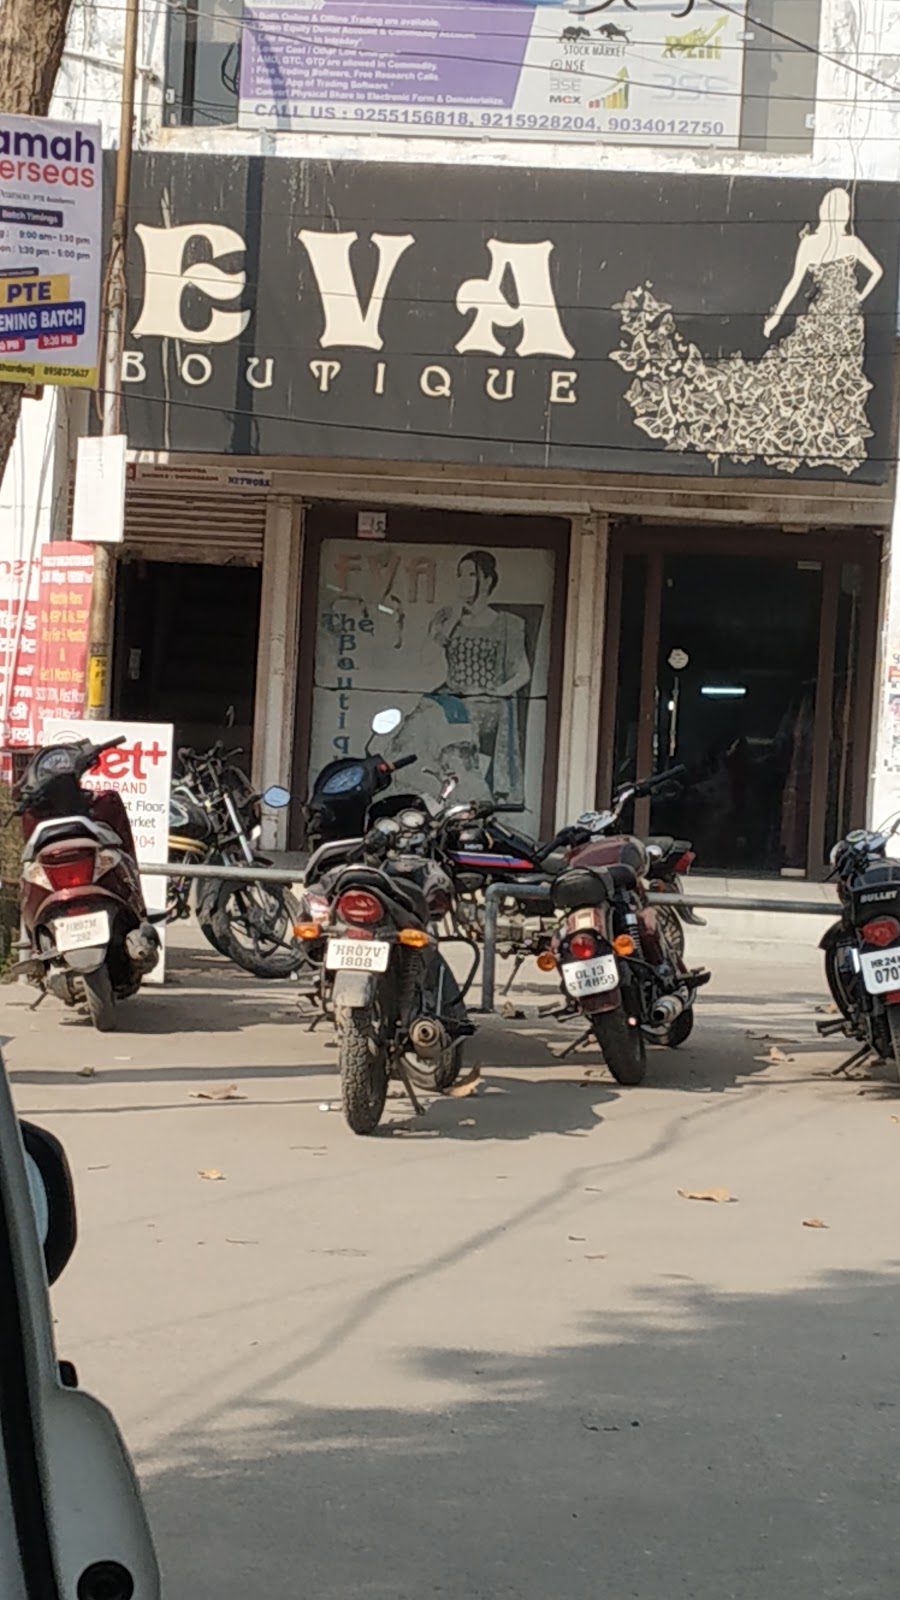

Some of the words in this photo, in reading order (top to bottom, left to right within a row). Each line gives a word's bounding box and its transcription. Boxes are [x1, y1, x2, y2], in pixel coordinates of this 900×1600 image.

[350, 15, 383, 27] Trading
[283, 24, 311, 34] Equity
[563, 44, 590, 56] STOCK
[592, 46, 627, 57] MARKET
[565, 60, 586, 71] NSE
[279, 67, 310, 77] Trading
[353, 69, 373, 78] Free
[374, 70, 416, 80] Research
[316, 79, 349, 90] Trading
[328, 90, 355, 99] Share
[411, 94, 435, 102] Form
[550, 95, 582, 104] MCX
[255, 103, 300, 118] CALL
[310, 105, 336, 119] US
[608, 117, 724, 136] 9034012750
[76, 237, 91, 245] pm
[36, 248, 50, 257] pm
[77, 252, 91, 260] pm
[7, 281, 52, 303] PTE
[131, 223, 576, 359] EVA
[41, 308, 82, 328] BATCH
[61, 335, 73, 344] PM
[121, 351, 577, 403] BOUTIQUE
[322, 612, 375, 636] The
[332, 634, 359, 759] Boutiq
[137, 801, 165, 814] Floor,
[860, 891, 898, 903] BULLET
[874, 965, 900, 984] 070
